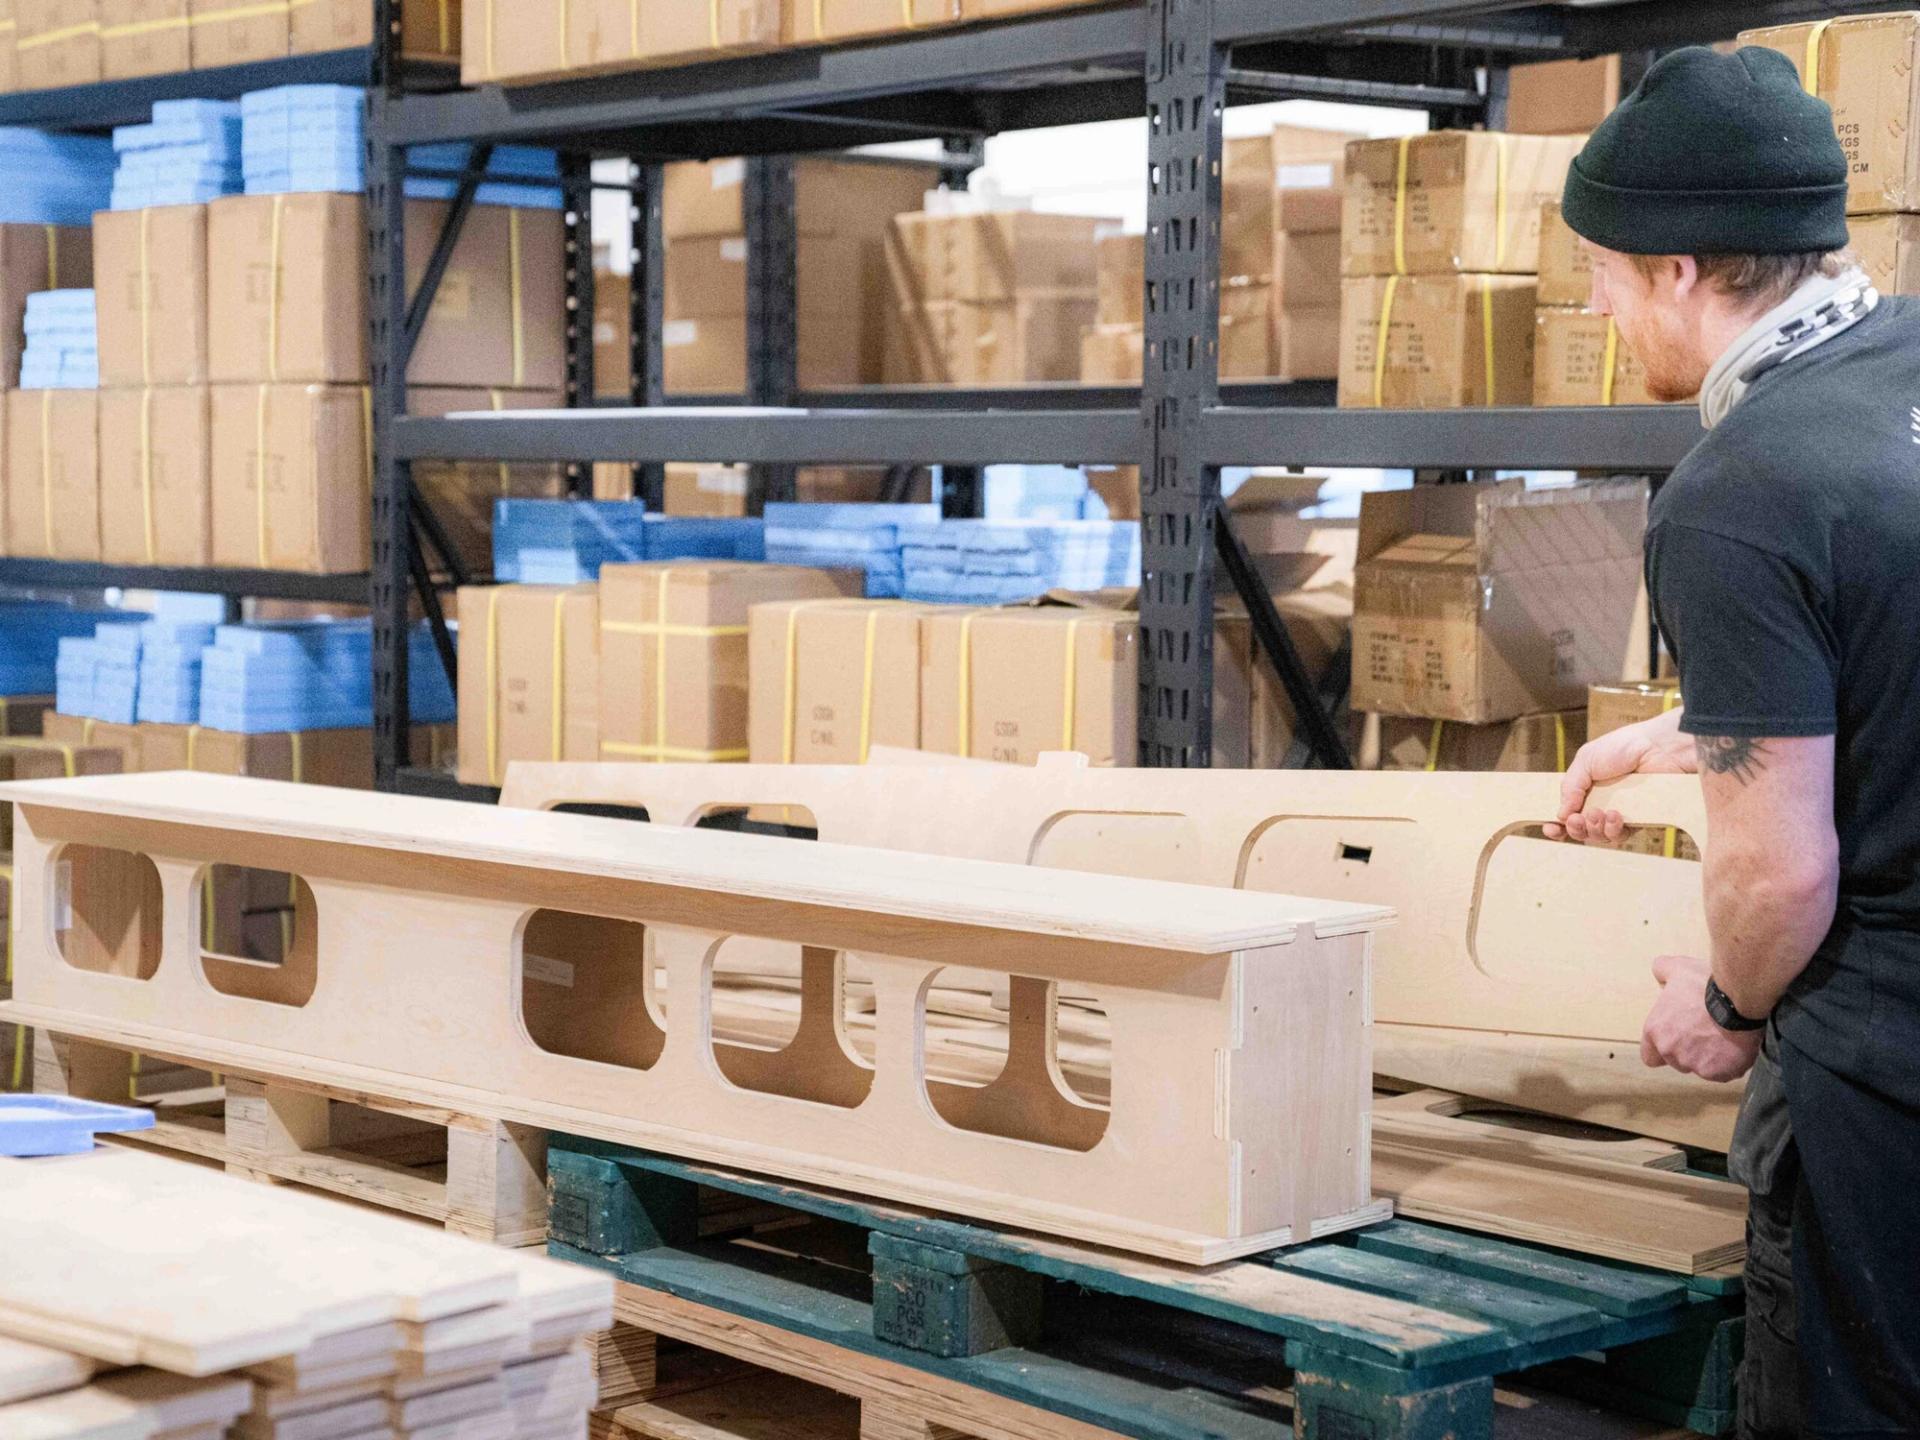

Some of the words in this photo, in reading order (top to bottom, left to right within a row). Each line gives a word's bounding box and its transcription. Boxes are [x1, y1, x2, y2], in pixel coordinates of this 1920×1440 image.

[1838, 124, 1859, 134] PCS
[1845, 151, 1859, 160] GS
[1852, 163, 1869, 173] CM
